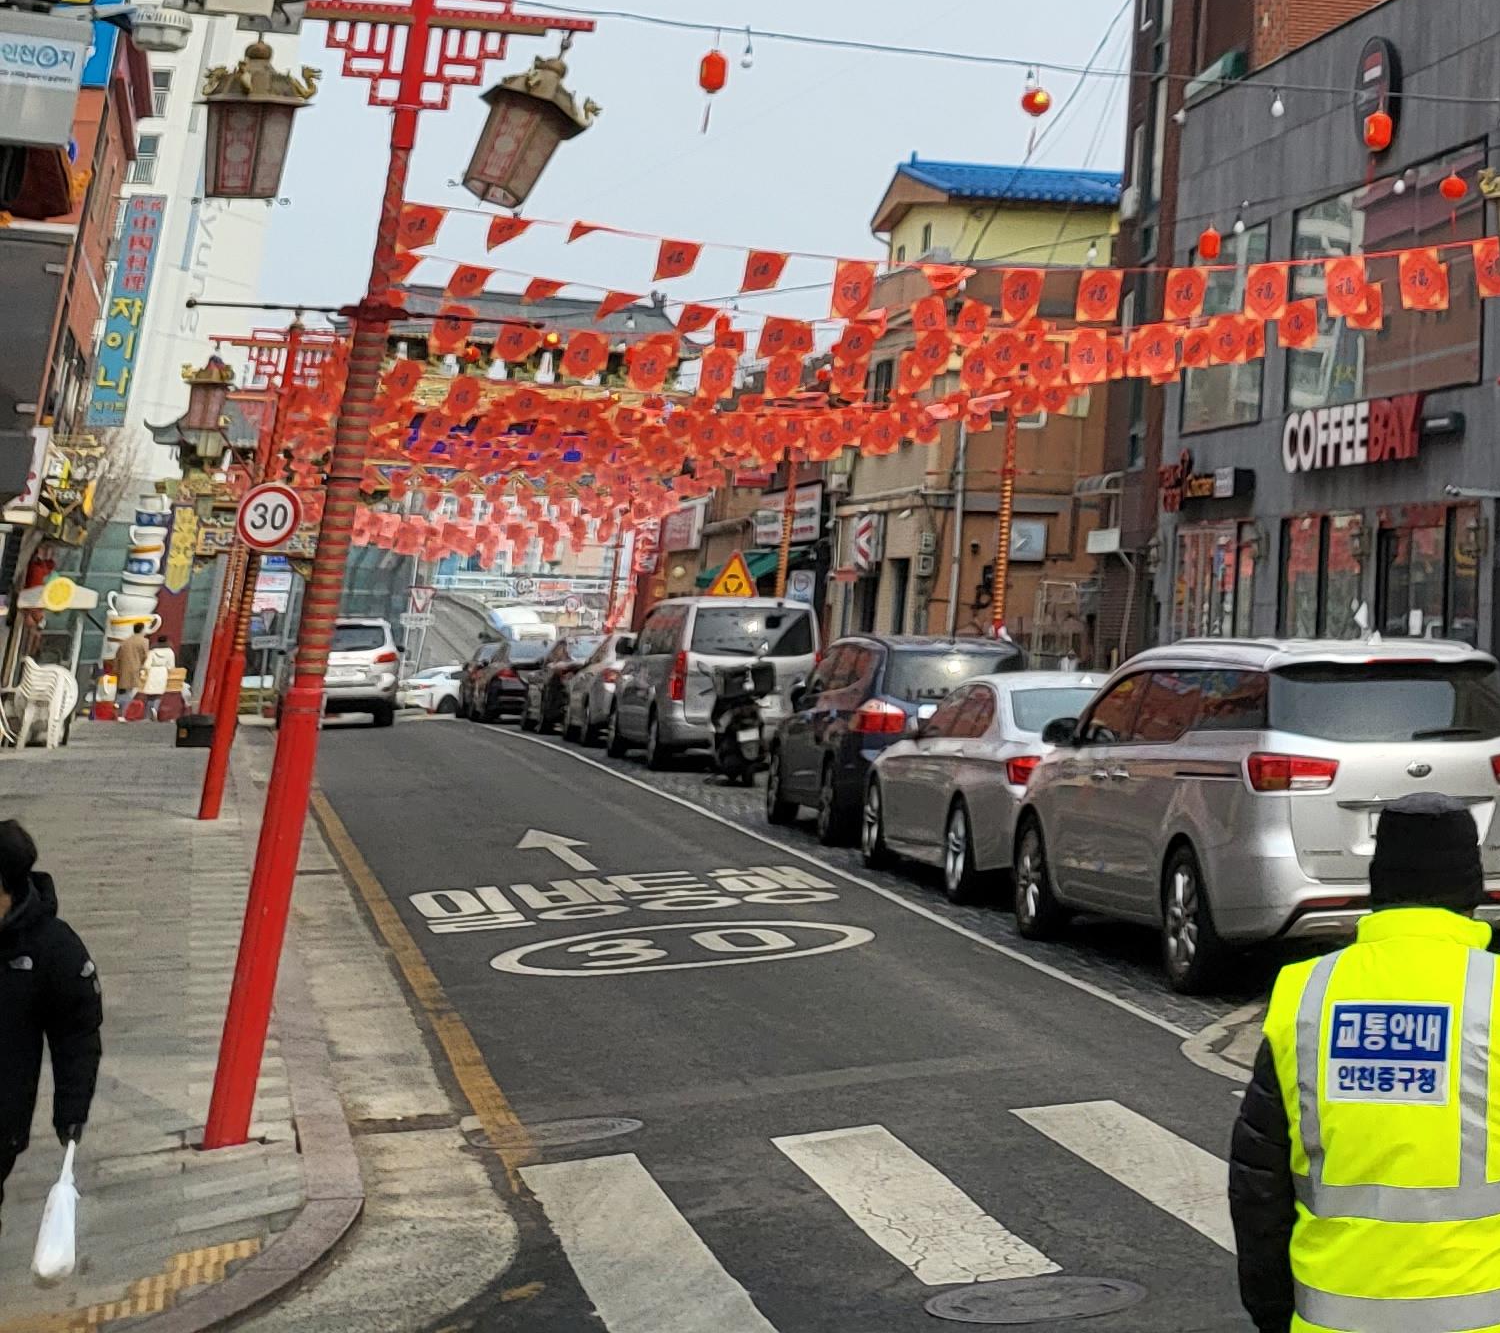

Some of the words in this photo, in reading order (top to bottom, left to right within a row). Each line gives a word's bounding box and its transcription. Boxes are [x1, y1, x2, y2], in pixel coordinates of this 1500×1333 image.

[250, 501, 289, 531] 30
[407, 864, 840, 934] 일방통행
[566, 928, 797, 968] 30
[1335, 1011, 1443, 1053] 교통안내
[1337, 1065, 1437, 1095] 인천중구청
